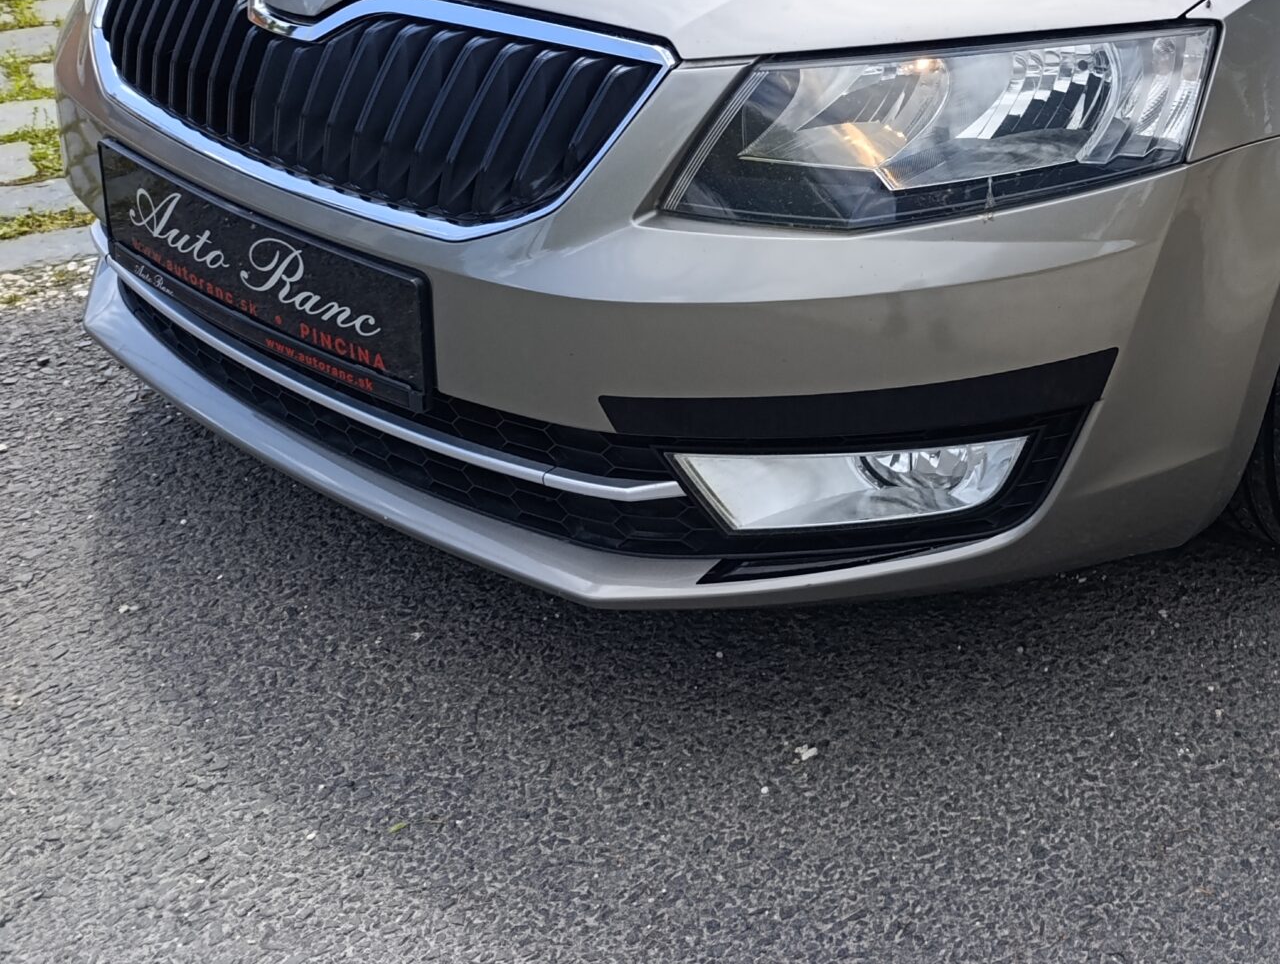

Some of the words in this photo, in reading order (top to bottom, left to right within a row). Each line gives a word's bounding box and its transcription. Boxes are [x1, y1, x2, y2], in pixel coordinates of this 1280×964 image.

[129, 187, 230, 269] Auto
[239, 237, 382, 337] Ranc
[264, 337, 374, 393] www.autoranc.sk
[299, 322, 387, 372] PINCINA
